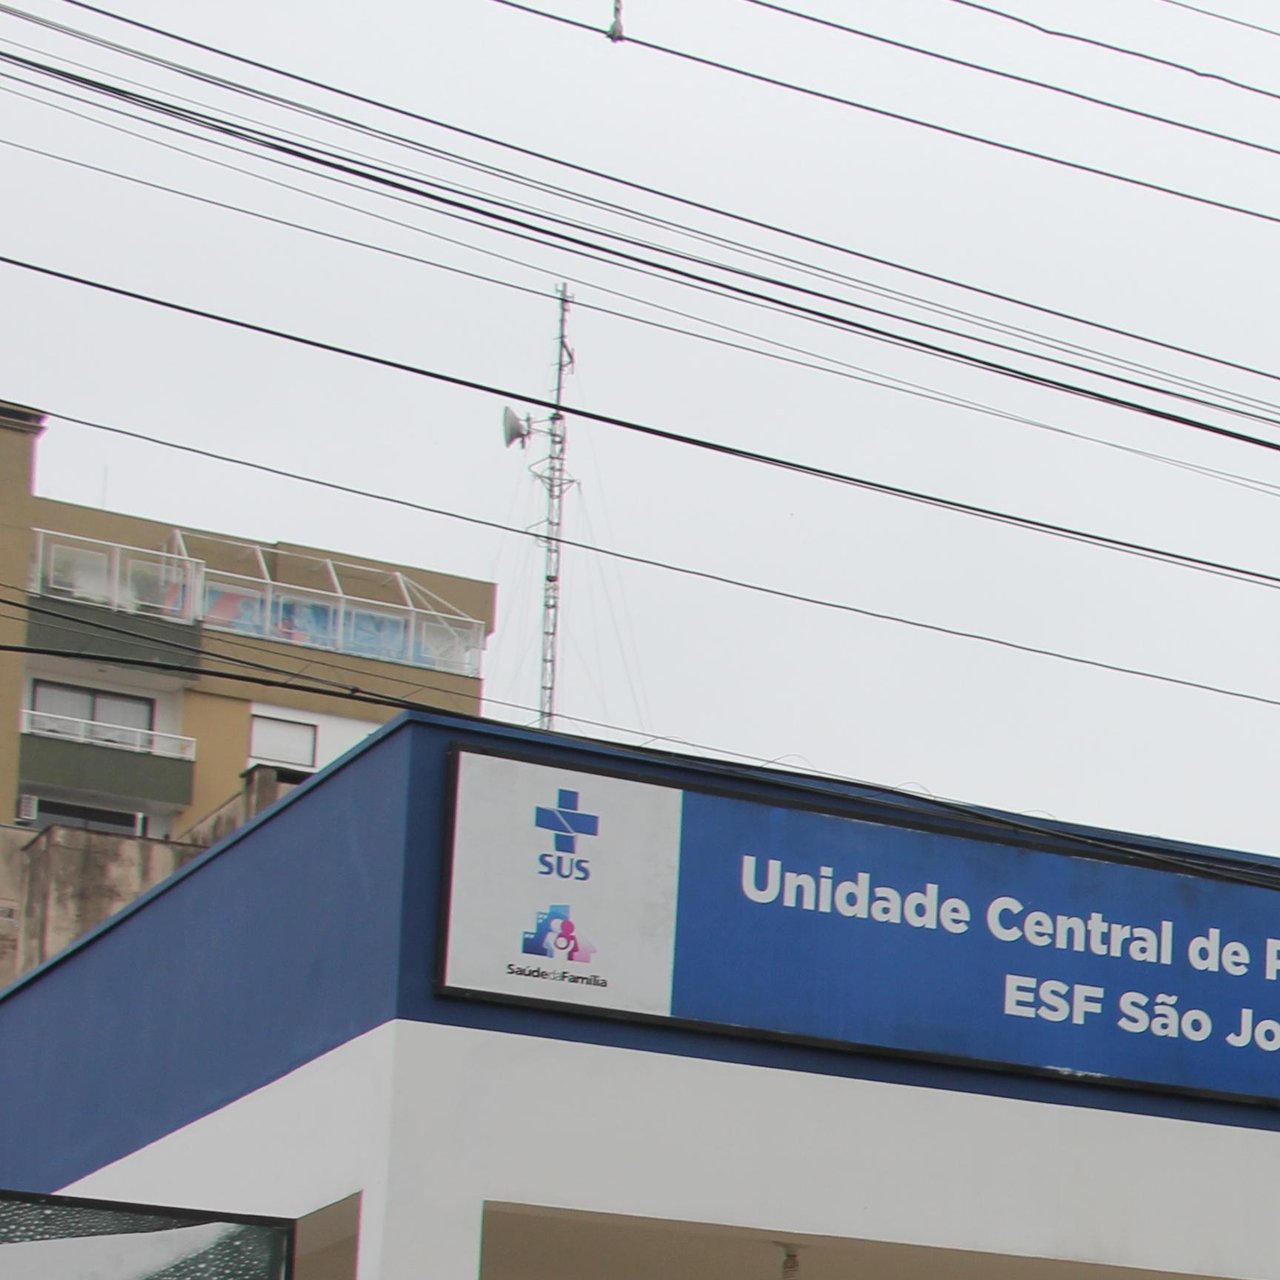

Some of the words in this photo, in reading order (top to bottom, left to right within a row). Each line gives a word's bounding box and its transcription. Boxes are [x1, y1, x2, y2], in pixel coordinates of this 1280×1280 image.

[538, 853, 591, 881] SUS
[741, 855, 971, 935] Unidade
[985, 896, 1172, 966] Central
[1188, 928, 1250, 976] de
[1003, 974, 1104, 1025] ESF
[1117, 989, 1213, 1043] São
